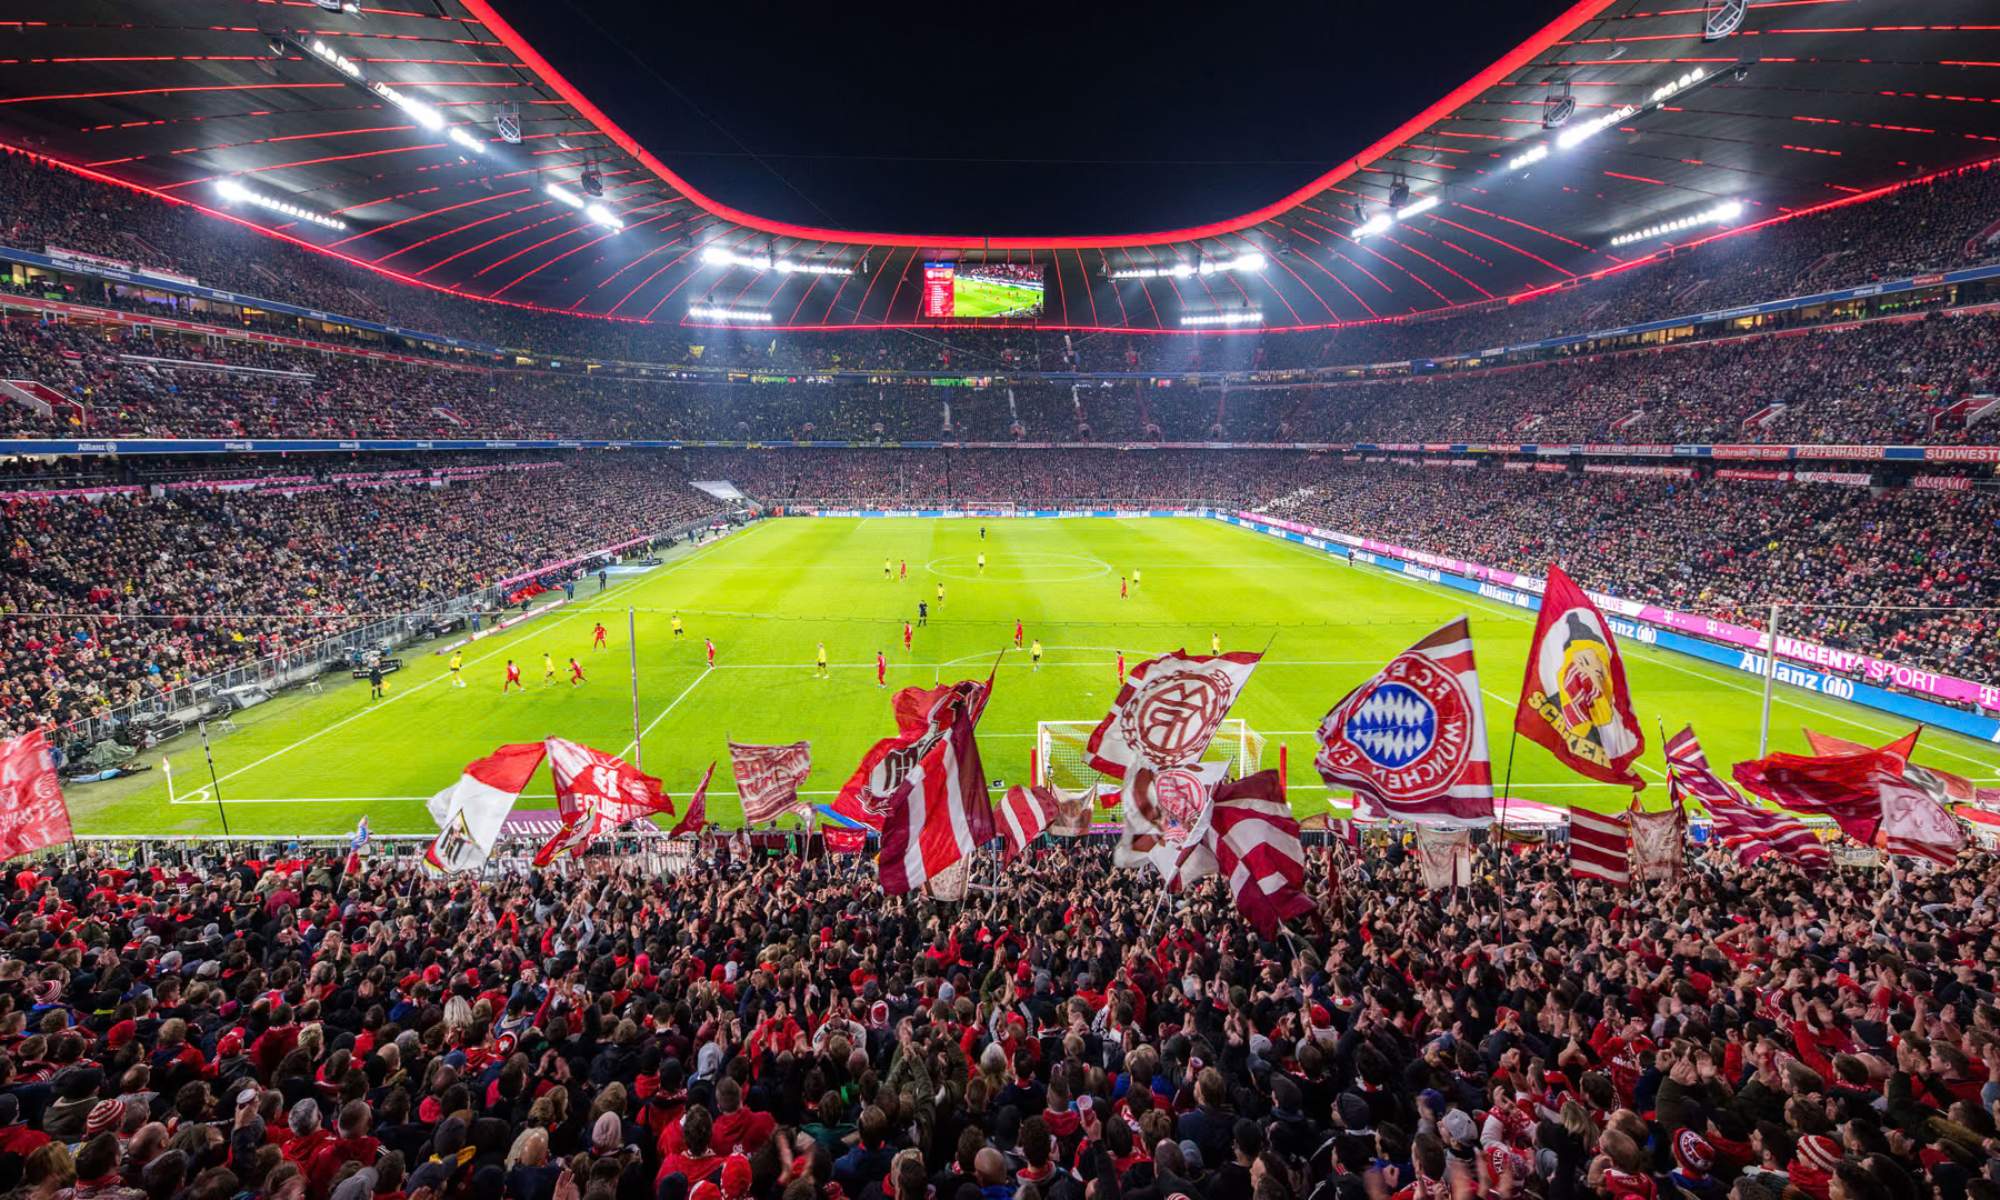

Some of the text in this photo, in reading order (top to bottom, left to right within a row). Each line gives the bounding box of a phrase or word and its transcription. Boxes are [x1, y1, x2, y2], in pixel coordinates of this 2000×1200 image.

[78, 443, 105, 451] Allianz
[1796, 447, 1883, 458] PFAFFENHAUSEN
[1404, 563, 1429, 579] Allianz
[1478, 582, 1514, 603] Allianz
[1739, 652, 1818, 690] Allianz
[1776, 638, 1941, 692] MAGENTA SPORT
